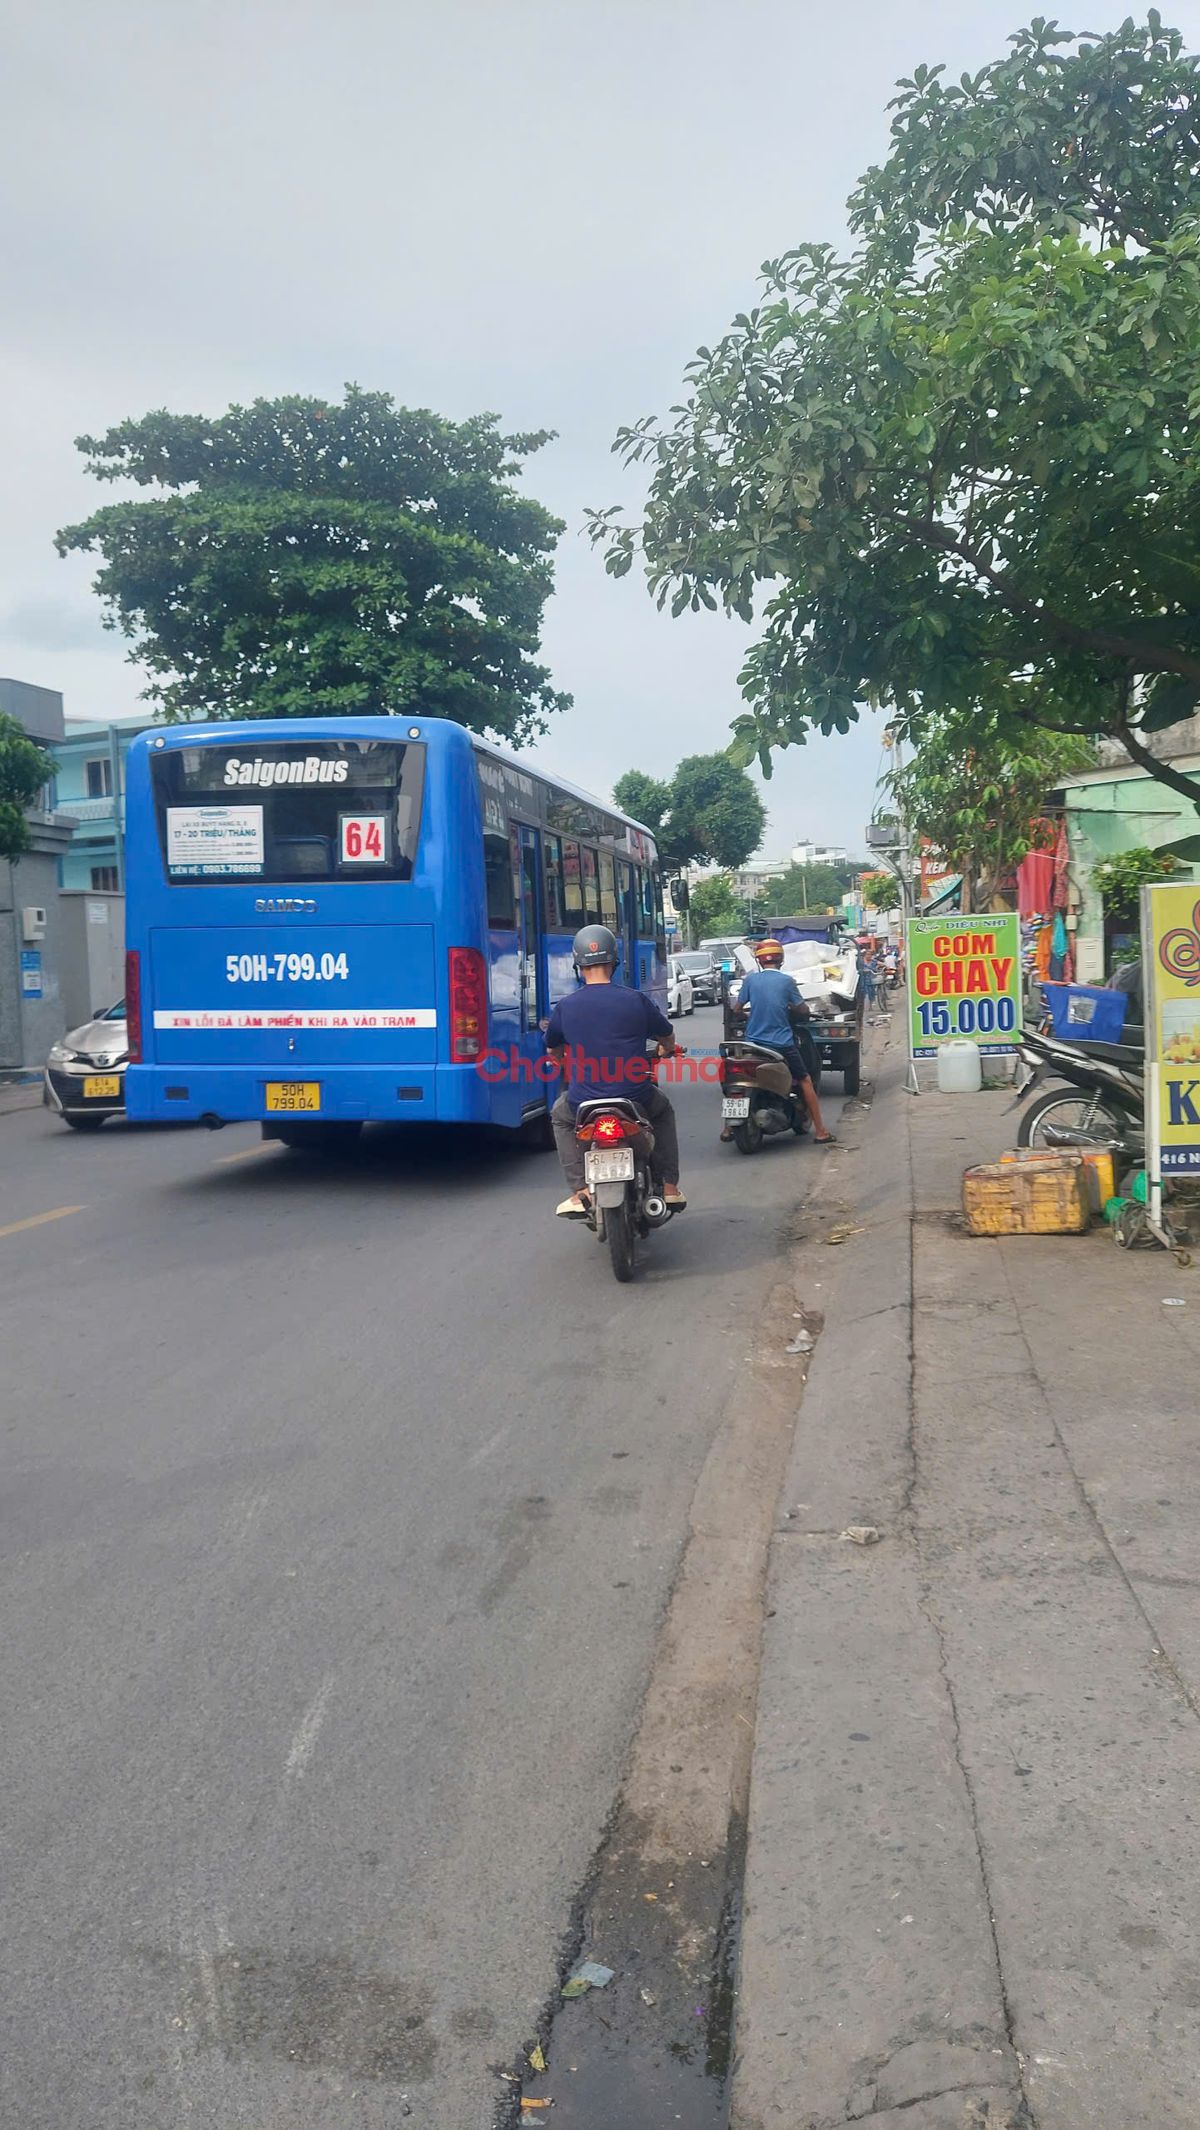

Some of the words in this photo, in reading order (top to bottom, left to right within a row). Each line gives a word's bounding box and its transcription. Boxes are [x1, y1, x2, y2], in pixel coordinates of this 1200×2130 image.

[224, 756, 349, 787] SaigonBus
[346, 822, 382, 857] 64
[934, 932, 995, 957] CƠM
[226, 952, 349, 982] 50H-799.04
[916, 958, 1012, 996] CHAY
[173, 1017, 190, 1027] XIN
[308, 1017, 327, 1026] KHI
[333, 1017, 348, 1026] RA
[917, 997, 1014, 1035] 15.000
[273, 1098, 314, 1109] 799.04
[282, 1084, 305, 1096] 50H
[1161, 1153, 1187, 1164] 416
